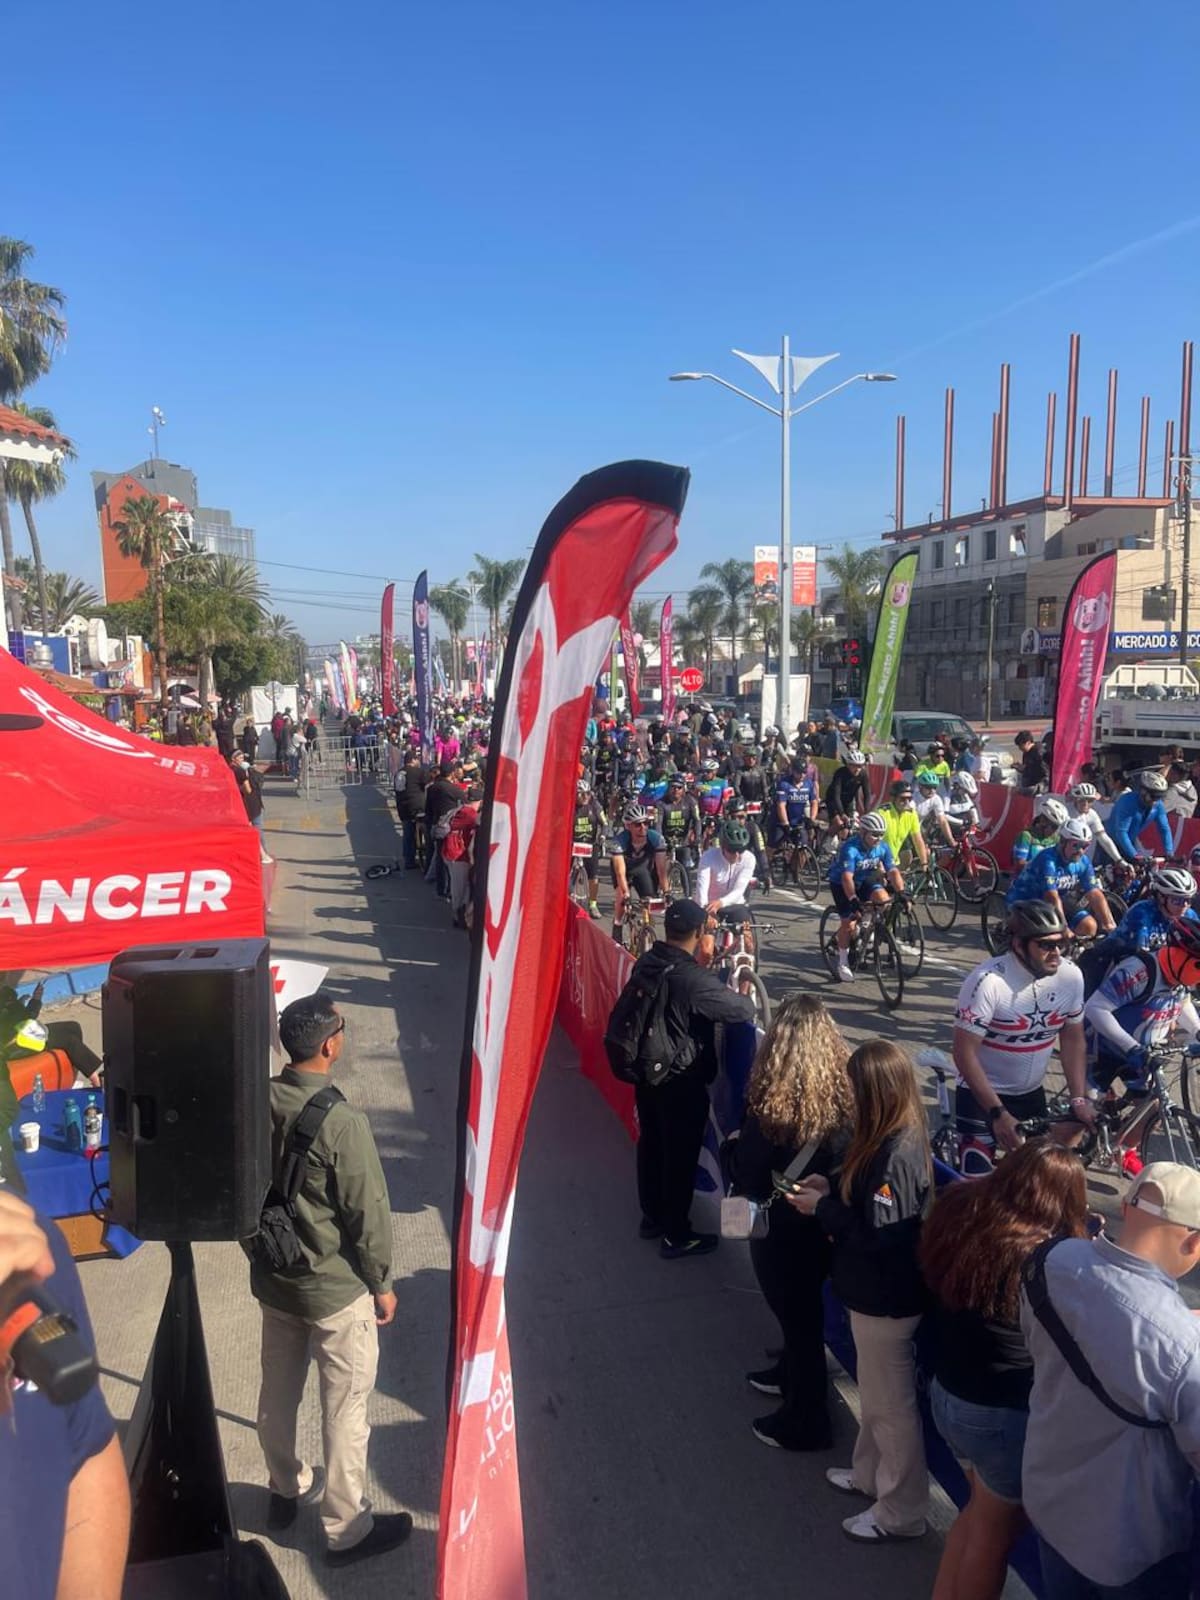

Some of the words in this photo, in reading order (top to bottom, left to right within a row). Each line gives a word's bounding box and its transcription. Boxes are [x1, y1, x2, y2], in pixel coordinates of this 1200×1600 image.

[1115, 634, 1167, 648] MERCADO
[1169, 634, 1179, 648] &
[682, 674, 702, 686] ALTO
[0, 867, 232, 926] ÁNCER
[984, 1029, 1059, 1043] TRE
